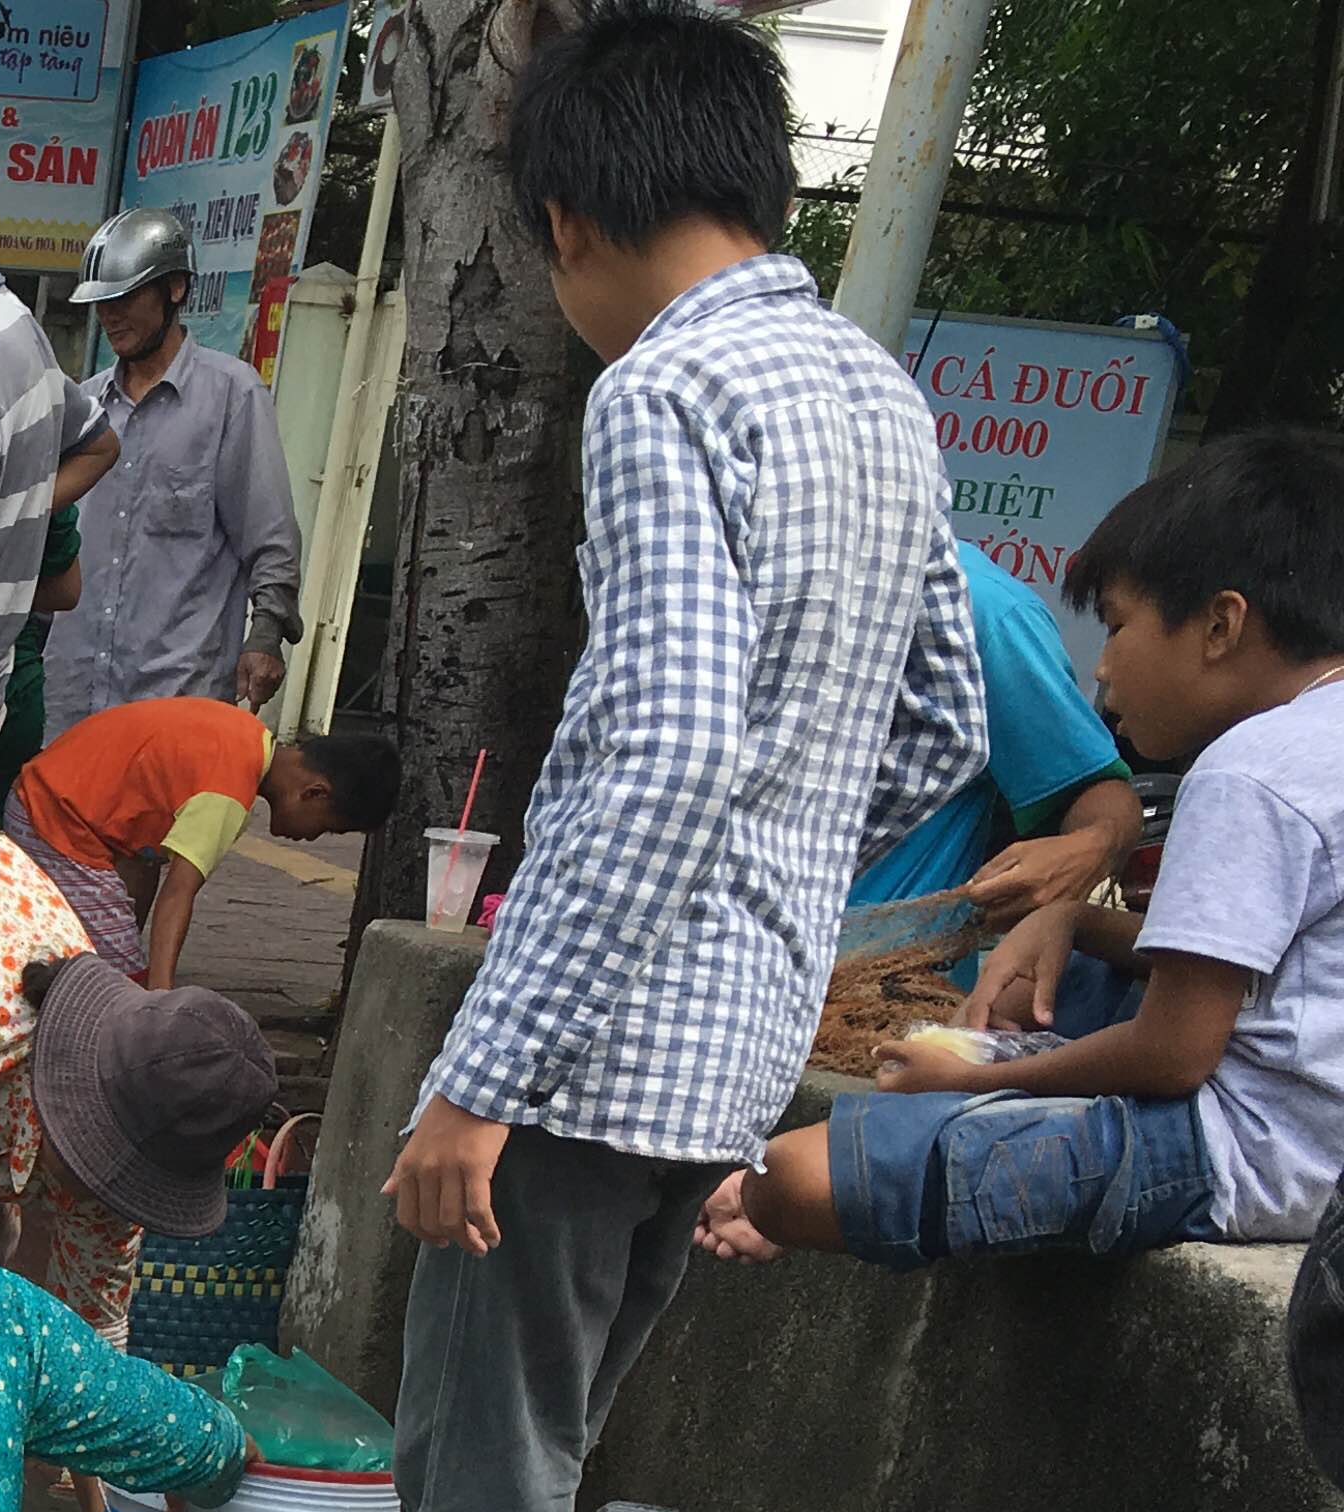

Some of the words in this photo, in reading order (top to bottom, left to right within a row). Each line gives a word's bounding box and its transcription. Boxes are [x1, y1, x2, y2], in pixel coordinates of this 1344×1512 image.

[39, 25, 90, 48] niêu
[39, 49, 84, 96] tàng
[1, 106, 20, 127] &
[137, 101, 191, 177] QUÁN
[188, 96, 232, 161] ĂN
[219, 72, 277, 160] 123
[7, 136, 99, 185] SẢN
[930, 347, 996, 401] CÁ
[1012, 356, 1150, 415] ĐUỐI
[934, 411, 1050, 458] 0.000
[951, 472, 1055, 527] BIỆT
